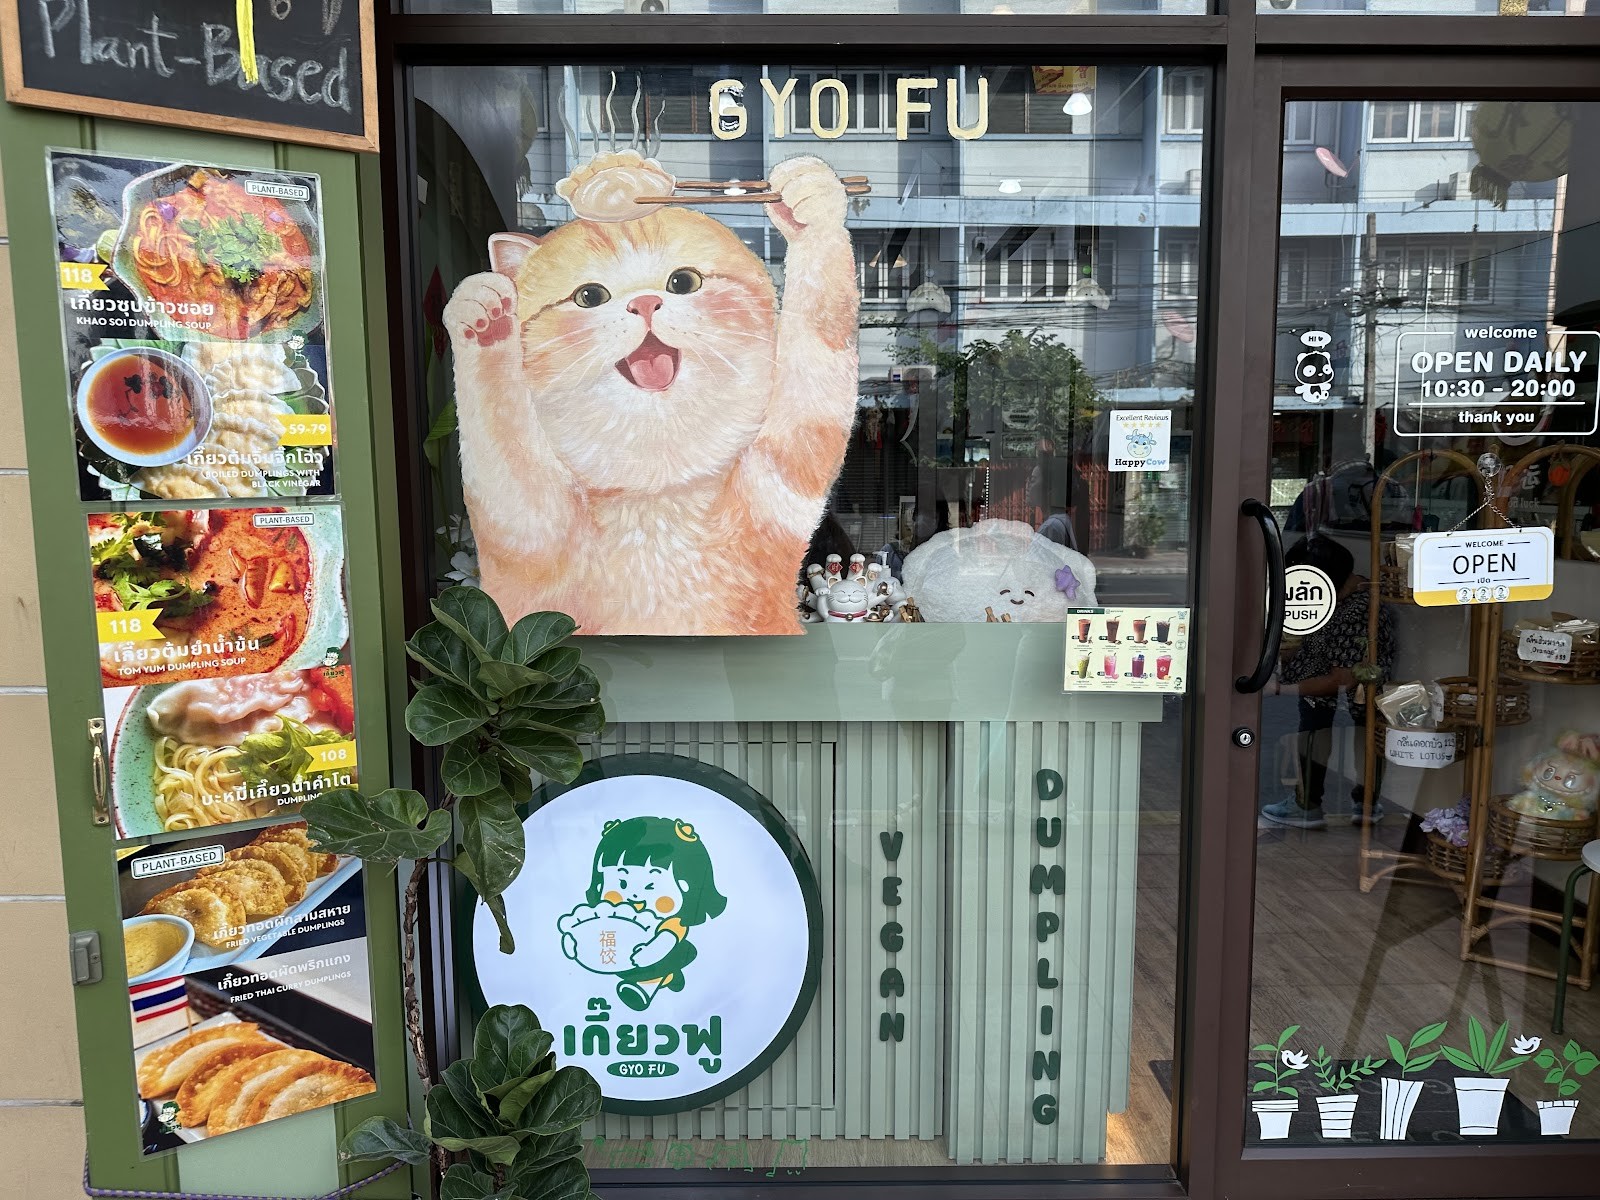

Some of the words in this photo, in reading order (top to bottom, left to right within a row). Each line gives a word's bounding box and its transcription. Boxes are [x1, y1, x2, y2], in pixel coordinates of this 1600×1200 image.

[38, 0, 351, 114] Plant-Based
[709, 78, 848, 140] GYO
[896, 78, 988, 140] FU
[251, 184, 304, 198] PLANT-BASED
[63, 268, 93, 284] 118
[76, 316, 107, 326] KHAO
[109, 318, 127, 327] SOI
[129, 319, 182, 329] DUMPLING
[185, 321, 212, 330] SOUP
[1464, 326, 1538, 339] welcome
[1411, 351, 1493, 373] OPEN
[1504, 351, 1587, 373] DAILY
[1421, 380, 1485, 397] 10:30
[1510, 380, 1576, 397] 20:00
[1458, 410, 1502, 423] thank
[1506, 412, 1535, 426] you
[289, 424, 327, 435] 59-79
[206, 470, 238, 479] BOILED
[242, 469, 295, 478] DUMPLINGS
[296, 469, 320, 477] WITH
[283, 480, 321, 488] VINEGAR
[259, 515, 310, 525] PLANT-BASED
[1466, 540, 1504, 548] WELCOME
[1453, 552, 1516, 575] OPEN
[1285, 610, 1318, 620] PUSH
[109, 618, 142, 634] 118
[118, 667, 142, 676] TOM
[143, 665, 166, 674] YUM
[167, 660, 218, 672] DUMPLING
[221, 657, 246, 667] SOUP
[320, 749, 347, 762] 108
[1389, 750, 1414, 759] WHITE
[1420, 752, 1447, 760] LOTUS
[142, 851, 217, 873] PLANT-BASED
[226, 937, 249, 949] FRIED
[251, 927, 296, 943] VEGETABLE
[298, 918, 345, 934] DUMPLINGS
[879, 831, 905, 1042] VEGAN
[1030, 768, 1066, 1125] DUMPLING
[230, 992, 254, 1004] FRIED
[255, 987, 275, 998] THAI
[276, 982, 303, 995] CURRY
[304, 971, 351, 988] DUMPLINGS
[563, 997, 722, 1074] เกี๊ยวฟู
[619, 1063, 643, 1075] GYO
[648, 1063, 666, 1075] FU
